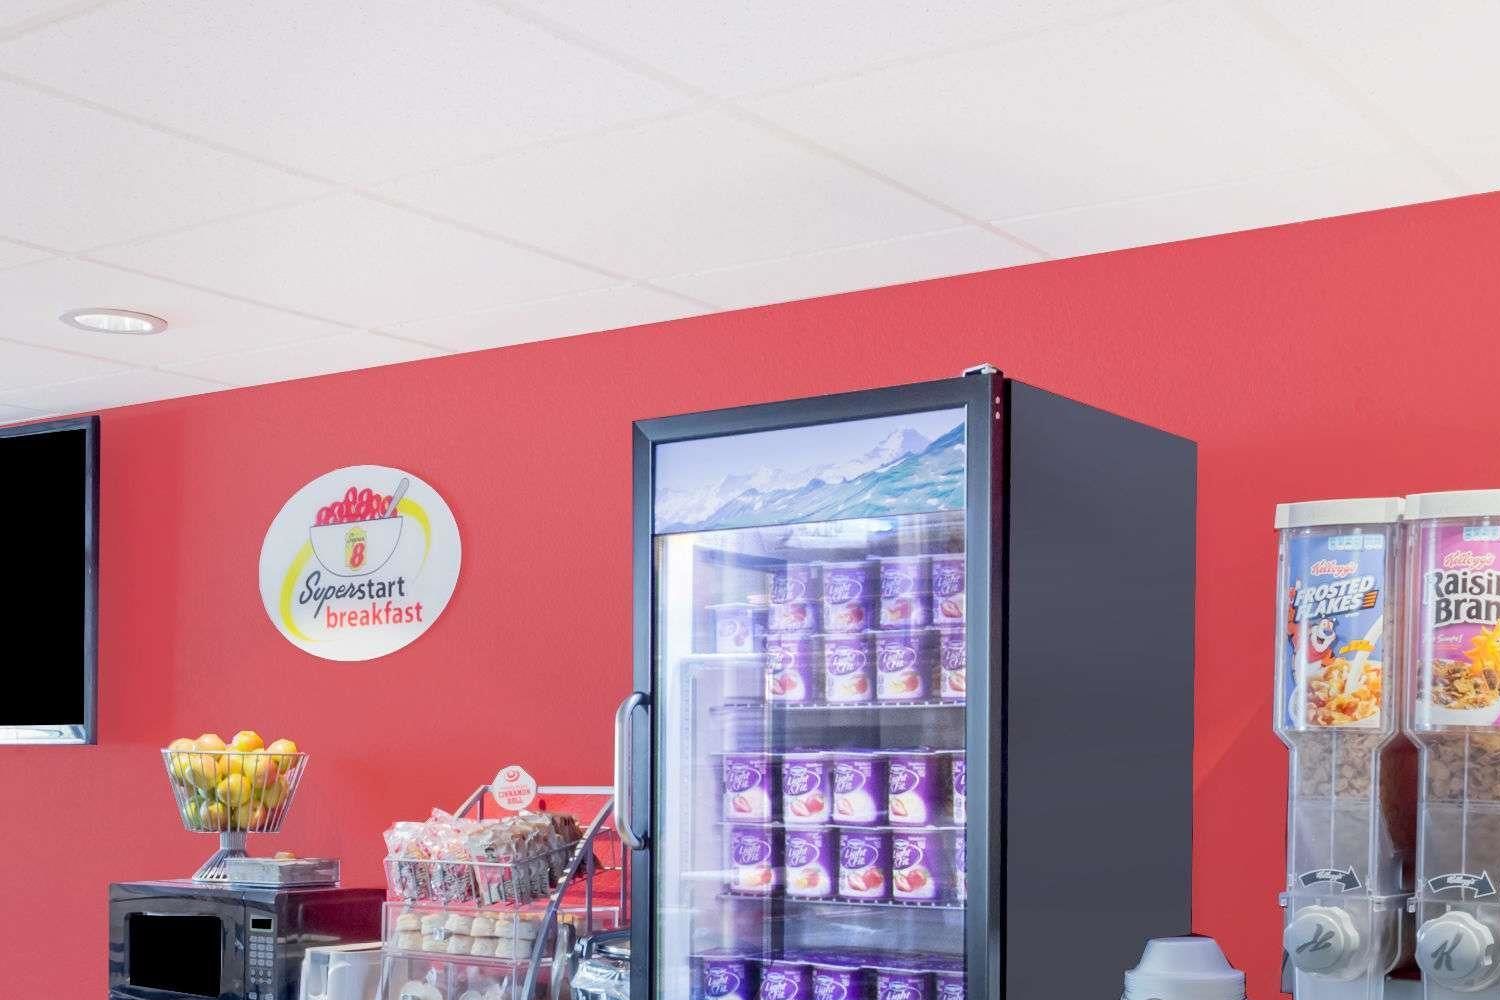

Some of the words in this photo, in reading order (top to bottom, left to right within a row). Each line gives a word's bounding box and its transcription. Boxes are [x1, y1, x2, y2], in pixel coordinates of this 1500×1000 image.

[1311, 559, 1358, 577] Kellogg's
[1443, 550, 1495, 569] Kellogg's
[299, 570, 406, 619] Superstart
[326, 600, 424, 628] breakfast
